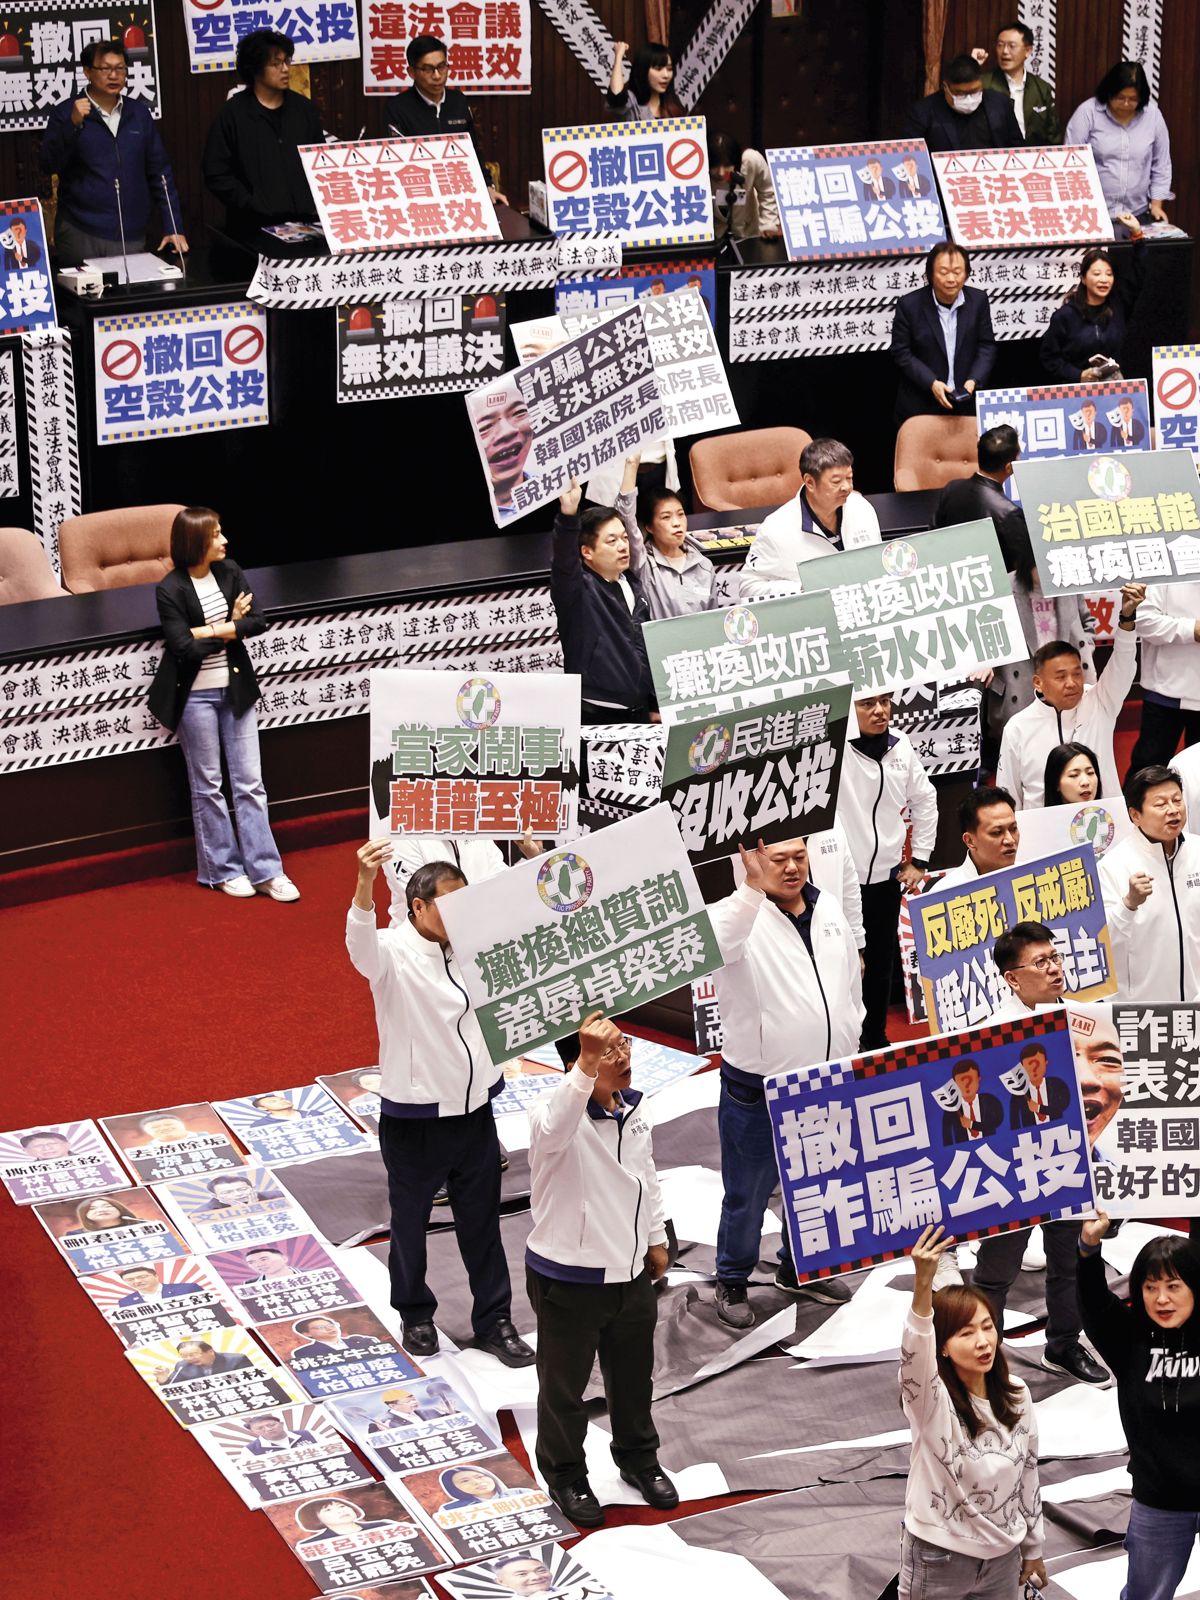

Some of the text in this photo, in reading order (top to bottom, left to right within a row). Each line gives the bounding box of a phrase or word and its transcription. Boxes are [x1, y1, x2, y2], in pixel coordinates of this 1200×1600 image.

[369, 1, 522, 41] 違法會議
[315, 161, 477, 207] 違法會議
[589, 142, 666, 188] 撤回
[777, 165, 857, 207] 撤回
[946, 170, 1094, 207] 違法會議
[328, 199, 488, 243] 表決無效
[553, 186, 708, 238] 空殼公投
[786, 200, 946, 248] 詐騙公投
[956, 204, 1103, 241] 表決無效
[258, 262, 484, 294] 違法會議 決議無效 違法會議
[733, 274, 876, 302] 違法會議 決議無效
[383, 296, 462, 337] 撤回
[733, 318, 876, 347] 違法會議 決議無效
[38, 336, 59, 408] 決議無效
[143, 330, 223, 376] 撤回
[342, 331, 503, 386] 無效議決
[519, 312, 648, 401] 詐騙公投
[104, 369, 265, 424] 空殼公投
[530, 346, 654, 433] 表決無效
[534, 379, 660, 466] 韓國瑜院長
[44, 416, 67, 493] 違法會議
[514, 408, 667, 511] 說好的協商呢
[1037, 492, 1200, 542] 治國無能
[832, 555, 994, 632] 癱瘓政府
[319, 622, 396, 650] 違法會議
[403, 610, 480, 638] 違法會議
[841, 603, 1012, 697] 薪水小偷
[2, 660, 131, 700] 會議 決議無效
[662, 622, 829, 701] 癱瘓政府
[0, 714, 132, 754] 會議 決議無效
[391, 722, 570, 776] 當家鬧事!
[728, 702, 832, 763] 民進黨
[389, 779, 568, 833] 離譜至極!
[669, 741, 837, 853] 沒收公投
[921, 858, 1095, 958] 反廢死! 反戒嚴!
[474, 869, 690, 998] 癱瘓總質詢
[494, 922, 705, 1050] 羞辱卓榮泰
[1071, 1016, 1091, 1031] IAR
[269, 1135, 350, 1159] 怕罷免
[779, 1082, 930, 1181] 撤回
[26, 1175, 107, 1198] 怕罷免
[152, 1156, 235, 1179] 怕罷免
[793, 1124, 1087, 1258] 詐騙公投
[218, 1222, 299, 1245] 怕罷免
[88, 1246, 176, 1271] 怕罷免
[256, 1282, 339, 1309] 林沛祥
[263, 1294, 349, 1320] 怕罷免
[127, 1307, 216, 1335] 張智倫
[310, 1356, 398, 1381] 牛煦庭
[318, 1369, 407, 1394] 怕罷免
[179, 1381, 269, 1410] 林德福
[188, 1394, 280, 1422] 怕罷免
[389, 1429, 478, 1458] 陳雪生
[400, 1441, 488, 1469] 怕罷免
[260, 1456, 351, 1485] 黃建賓
[269, 1469, 360, 1499] 怕罷免
[458, 1508, 551, 1541] 邱若華
[468, 1524, 563, 1554] 怕罷免
[321, 1541, 416, 1572] 呂玉玲
[329, 1555, 425, 1586] 怕罷免
